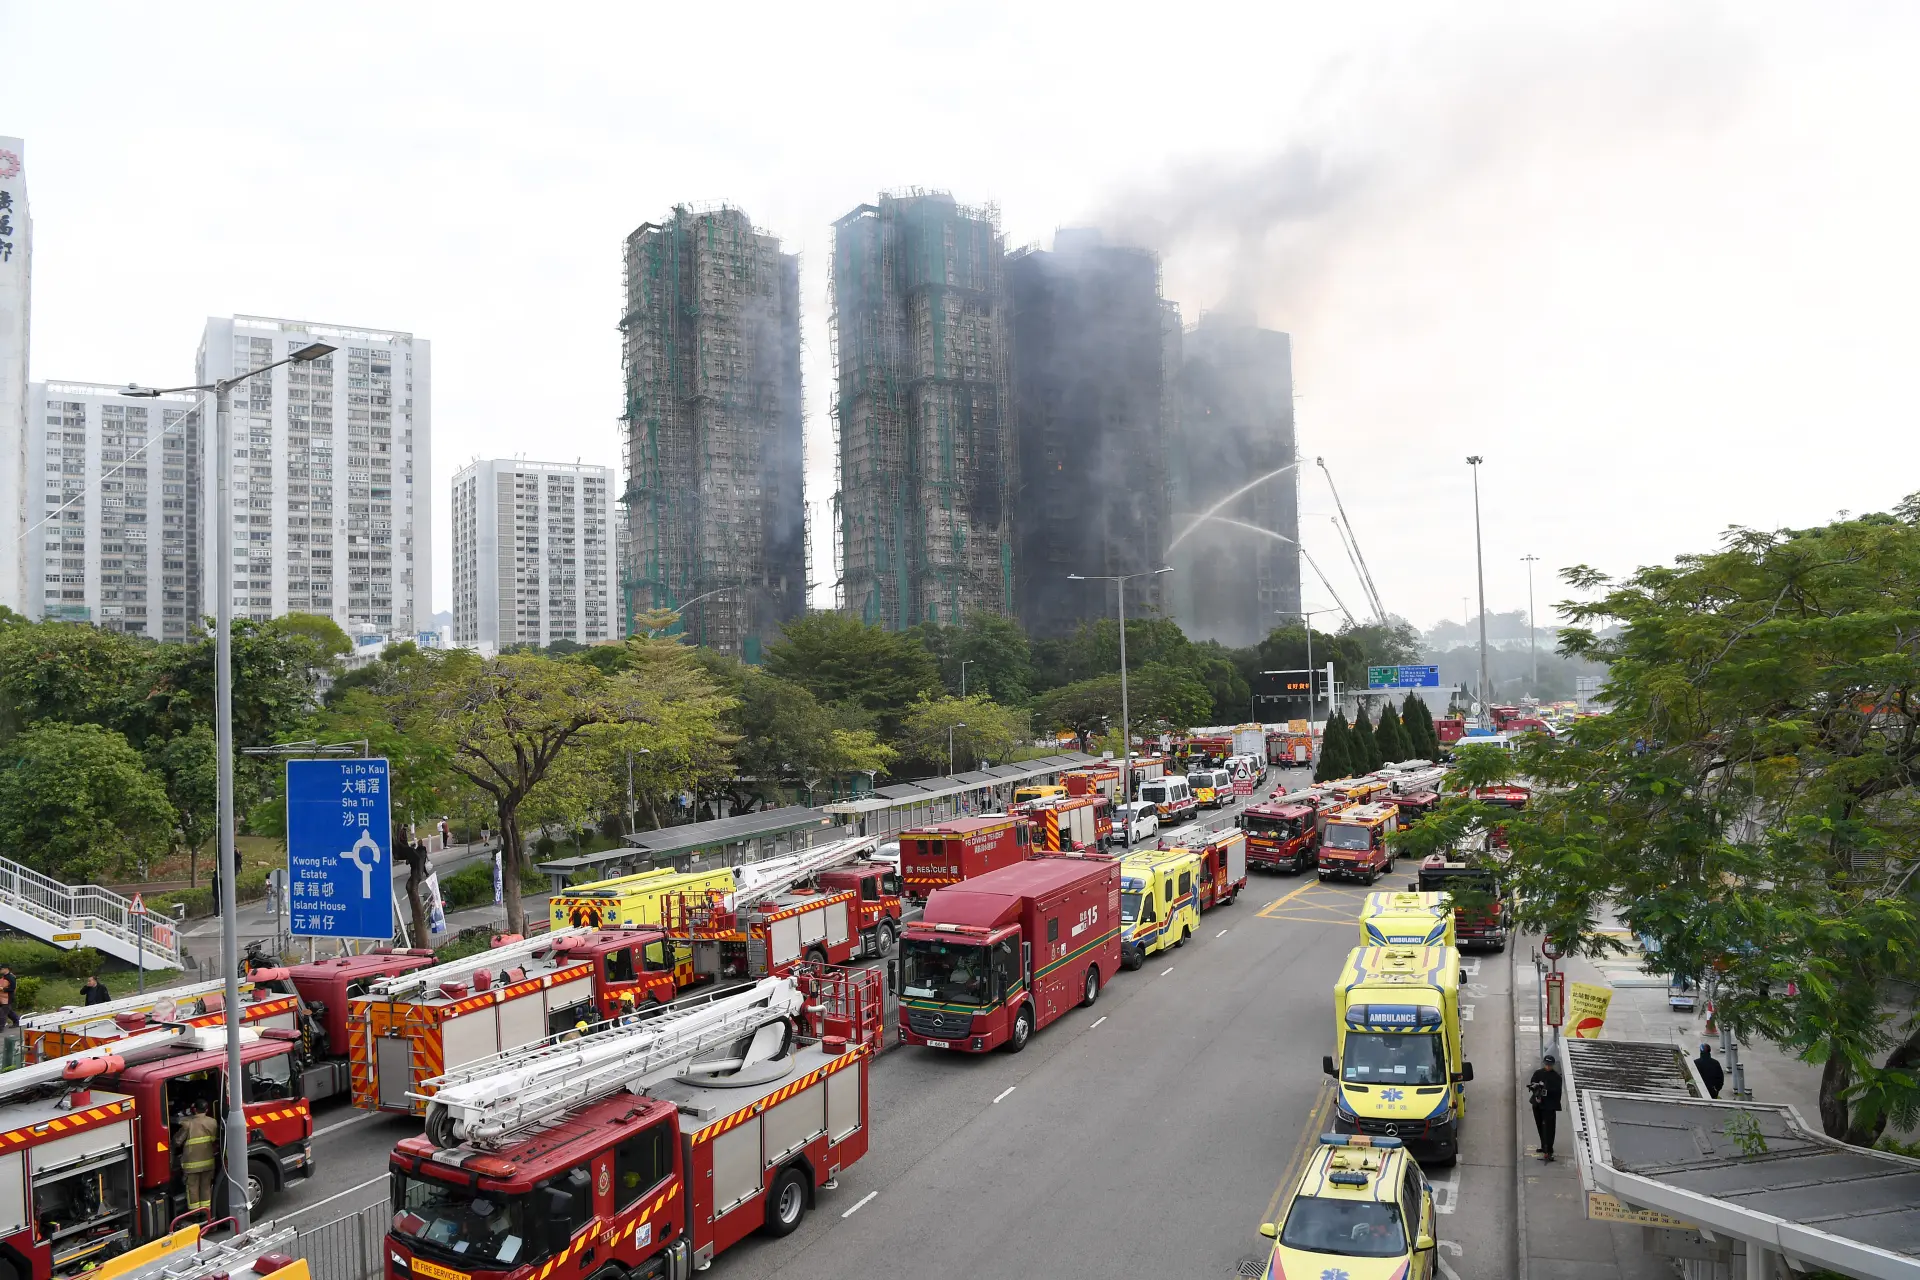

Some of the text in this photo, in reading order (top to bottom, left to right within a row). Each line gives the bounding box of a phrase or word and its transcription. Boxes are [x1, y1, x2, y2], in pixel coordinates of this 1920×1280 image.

[341, 765, 384, 774] Tai Po Kau
[341, 778, 380, 794] 大埔滘
[342, 797, 374, 807] Sha Tin
[342, 811, 370, 827] 沙田
[293, 856, 338, 867] Kwong Fuk
[301, 870, 328, 879] Estate
[916, 866, 947, 874] RESCUE
[293, 881, 334, 897] 廣福邨
[293, 900, 347, 911] Island House
[1087, 904, 1098, 926] 15
[294, 914, 335, 930] 元洲仔
[1369, 1013, 1417, 1023] AMBULANCE
[420, 1263, 433, 1274] FIRE
[433, 1267, 460, 1280] SERVICES
